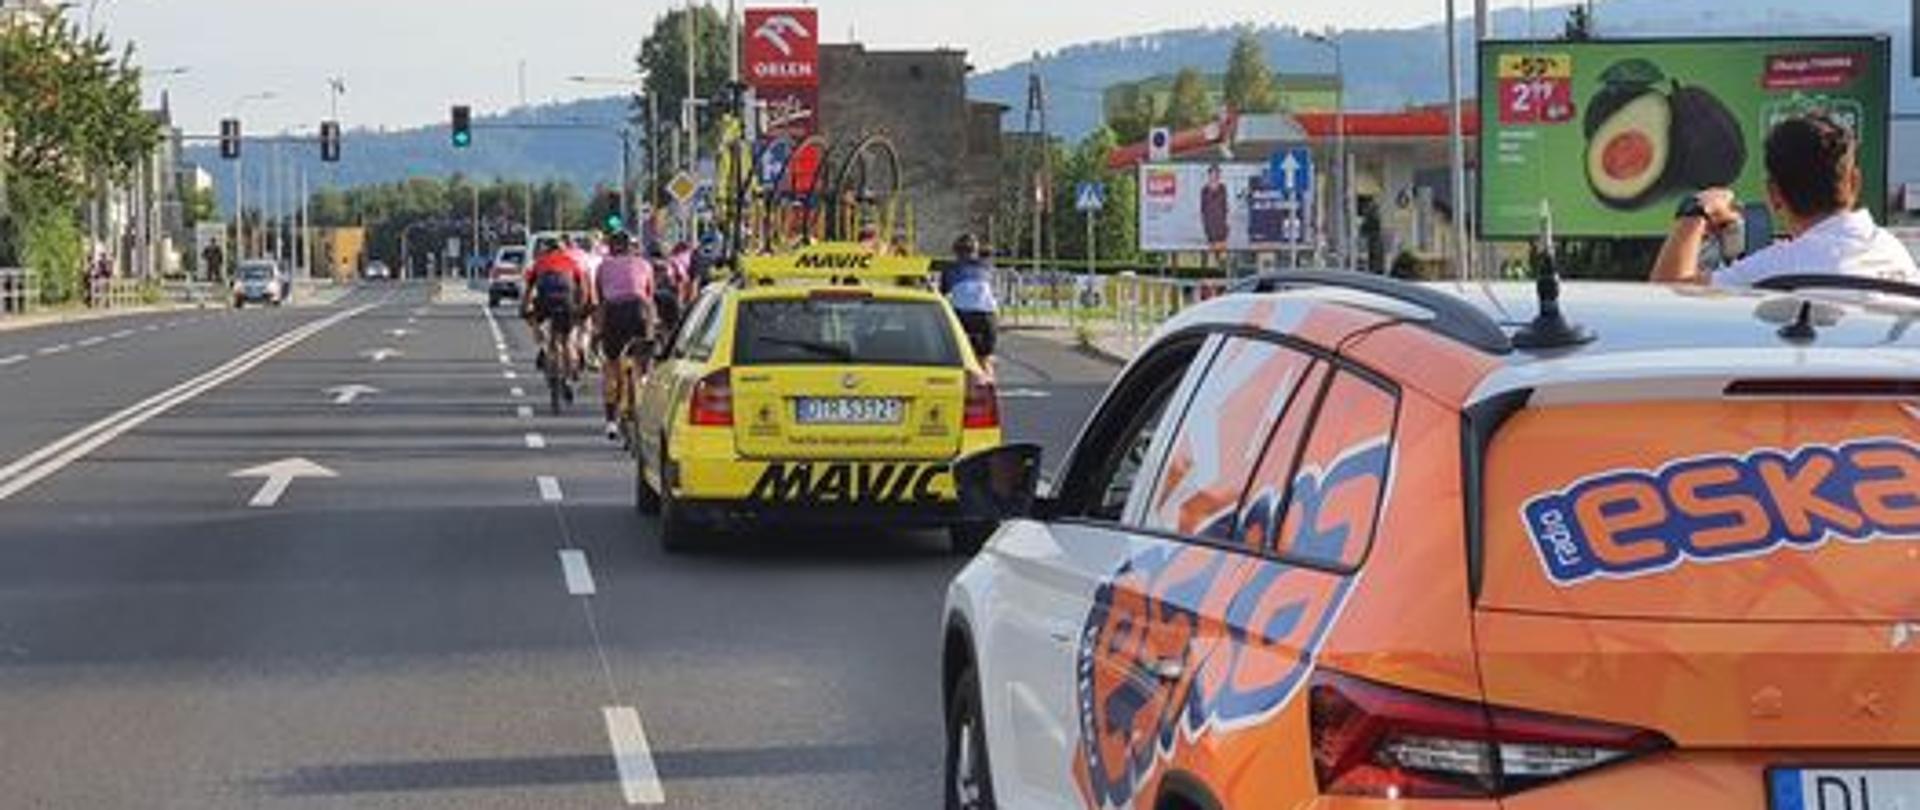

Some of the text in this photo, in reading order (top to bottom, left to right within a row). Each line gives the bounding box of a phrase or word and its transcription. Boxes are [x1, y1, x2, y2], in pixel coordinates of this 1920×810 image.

[755, 62, 811, 77] ORLEN
[795, 253, 872, 268] MAVIC
[752, 463, 957, 502] MAVIC
[1573, 448, 1920, 564] eska
[1539, 508, 1582, 566] radio
